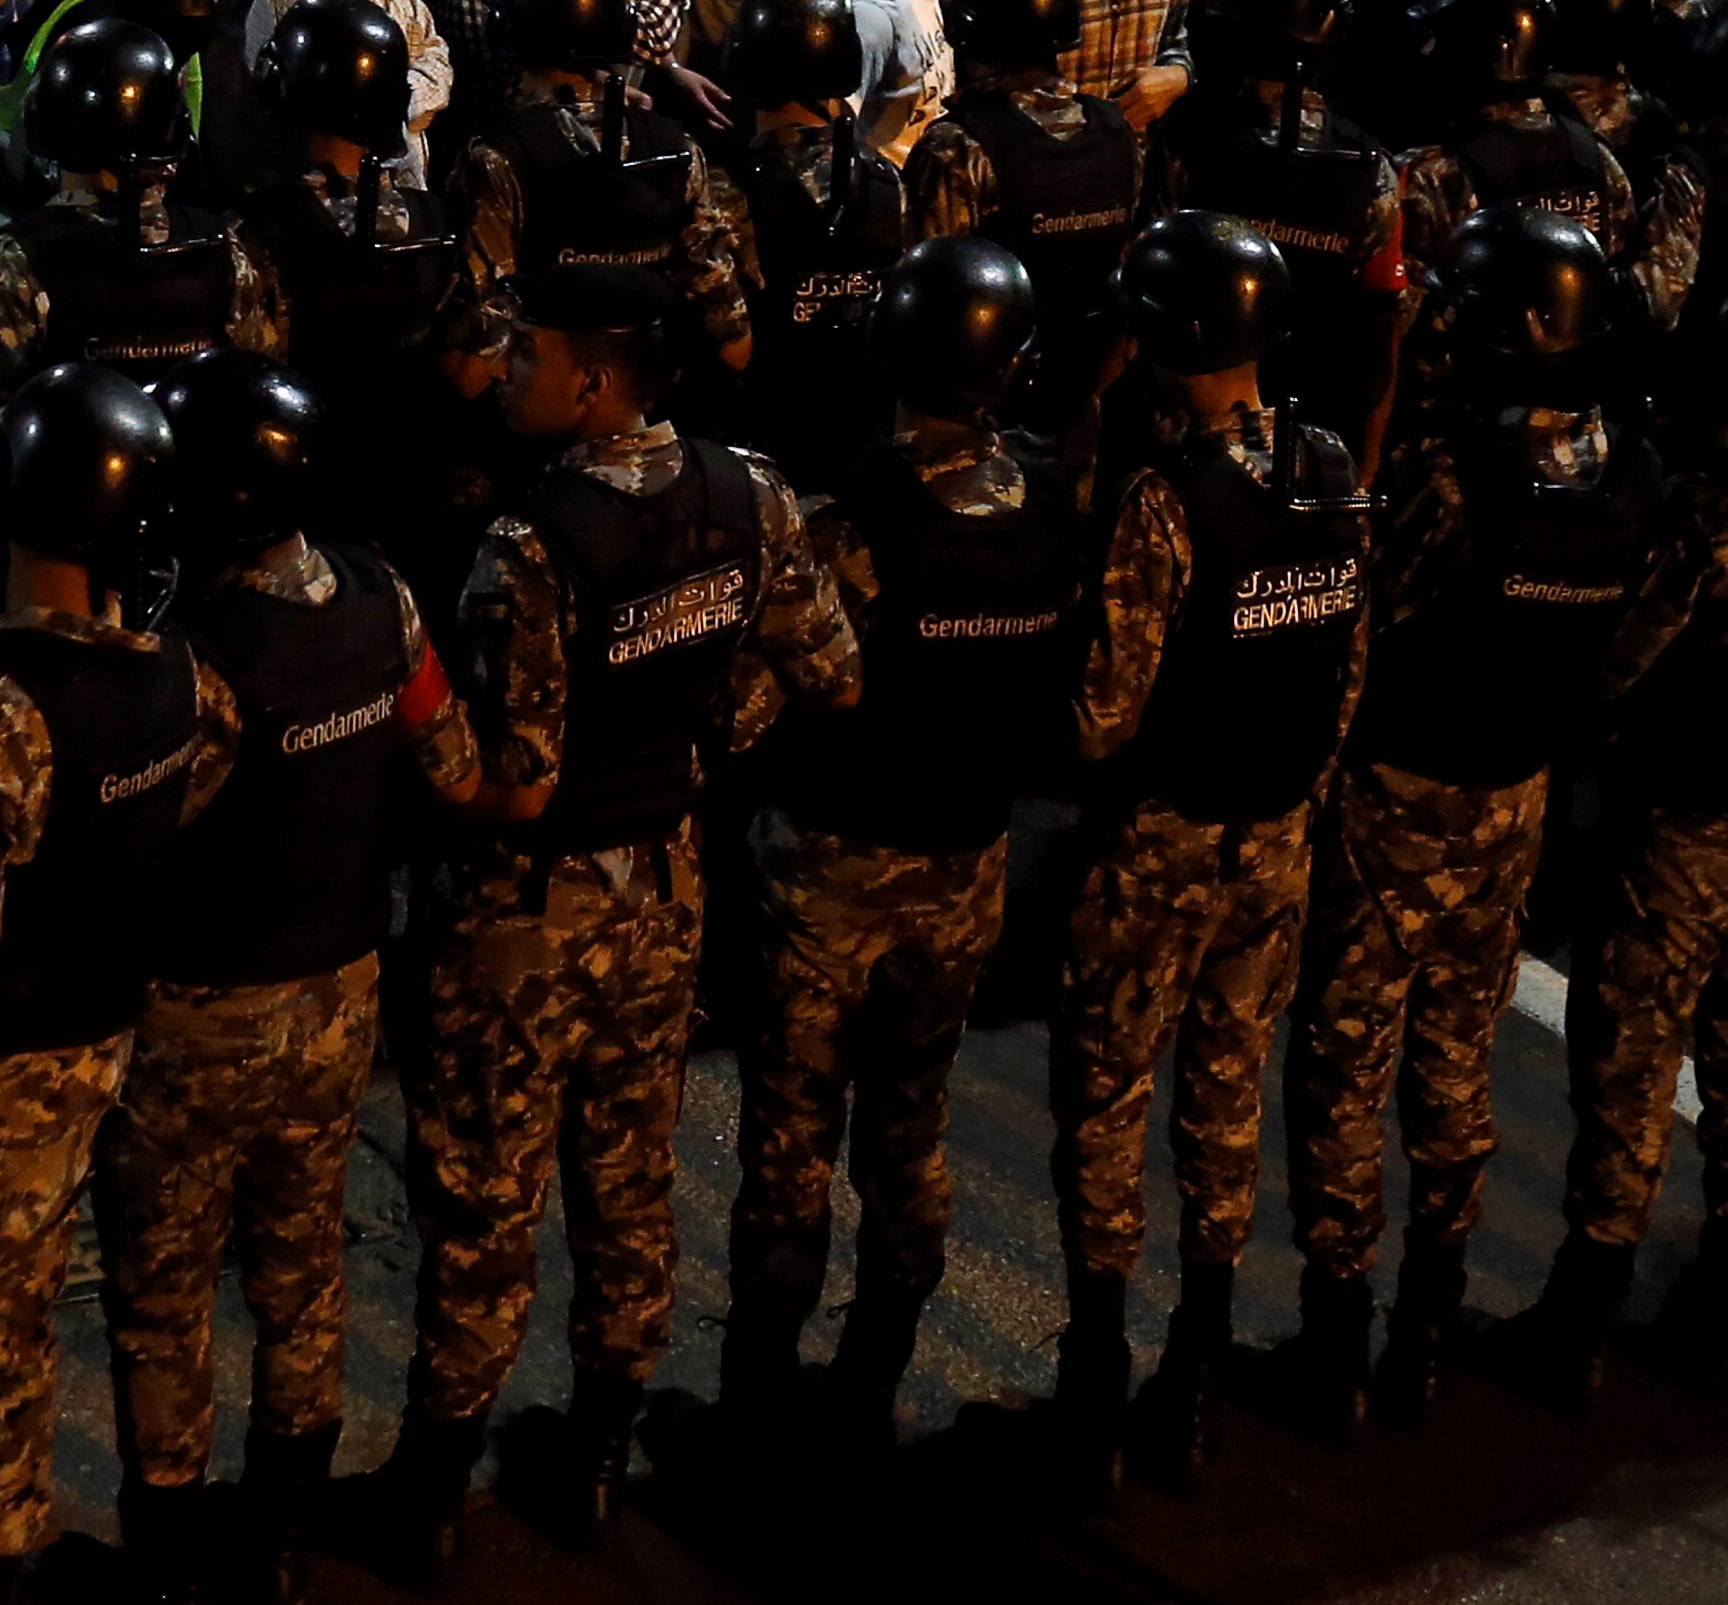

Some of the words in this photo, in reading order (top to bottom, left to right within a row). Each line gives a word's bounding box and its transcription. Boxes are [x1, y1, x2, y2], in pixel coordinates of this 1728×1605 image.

[677, 568, 745, 607] قوات
[607, 595, 745, 666] GENDARMERIE
[612, 594, 675, 633] الدرك
[919, 610, 1058, 640] Gendarmerie
[282, 692, 396, 756] Gendarmerie
